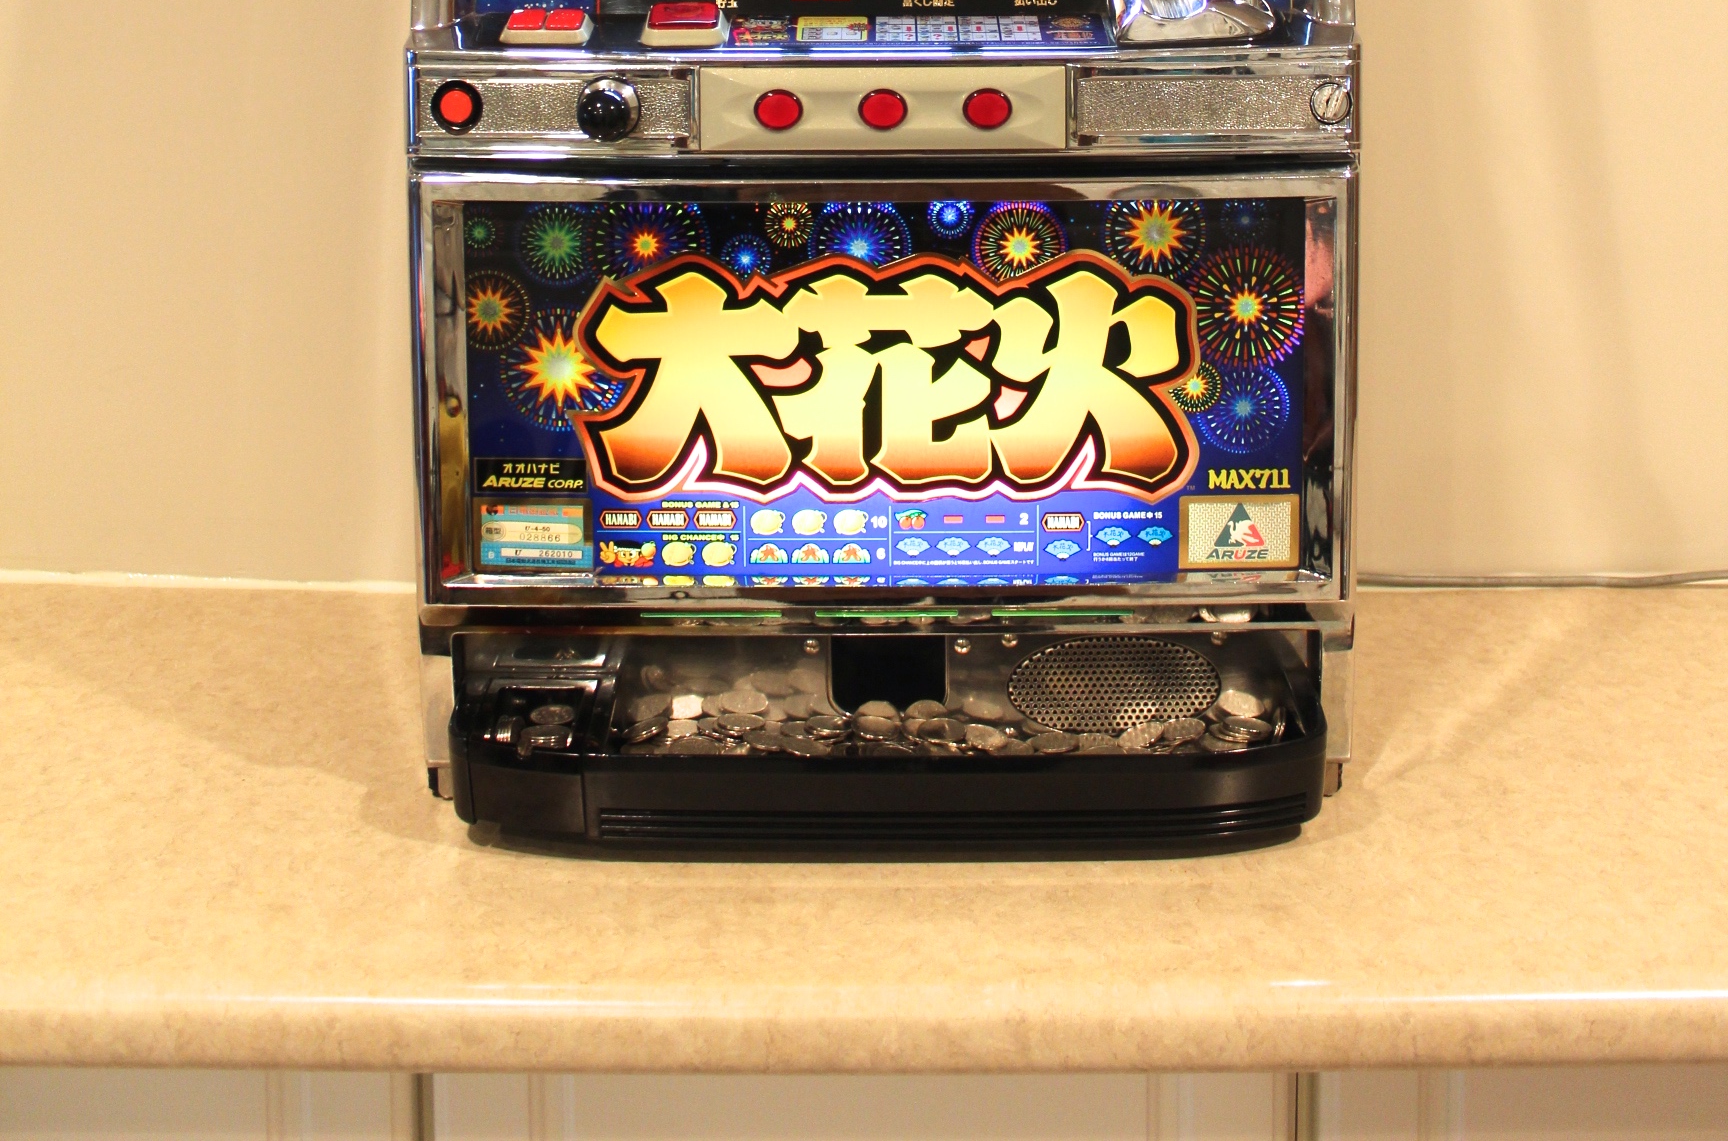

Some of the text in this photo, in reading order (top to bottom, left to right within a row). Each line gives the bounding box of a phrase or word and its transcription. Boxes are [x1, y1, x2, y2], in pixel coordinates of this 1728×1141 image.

[503, 463, 560, 474] オオハナビ
[482, 474, 584, 489] ARUZE CORP.
[605, 513, 637, 526] HANABI
[870, 515, 888, 529] 10
[1019, 512, 1029, 525] 2
[1093, 511, 1121, 520] BONUS
[539, 550, 574, 558] 262010
[876, 547, 886, 560] 6
[1204, 548, 1270, 560] ARUZE
